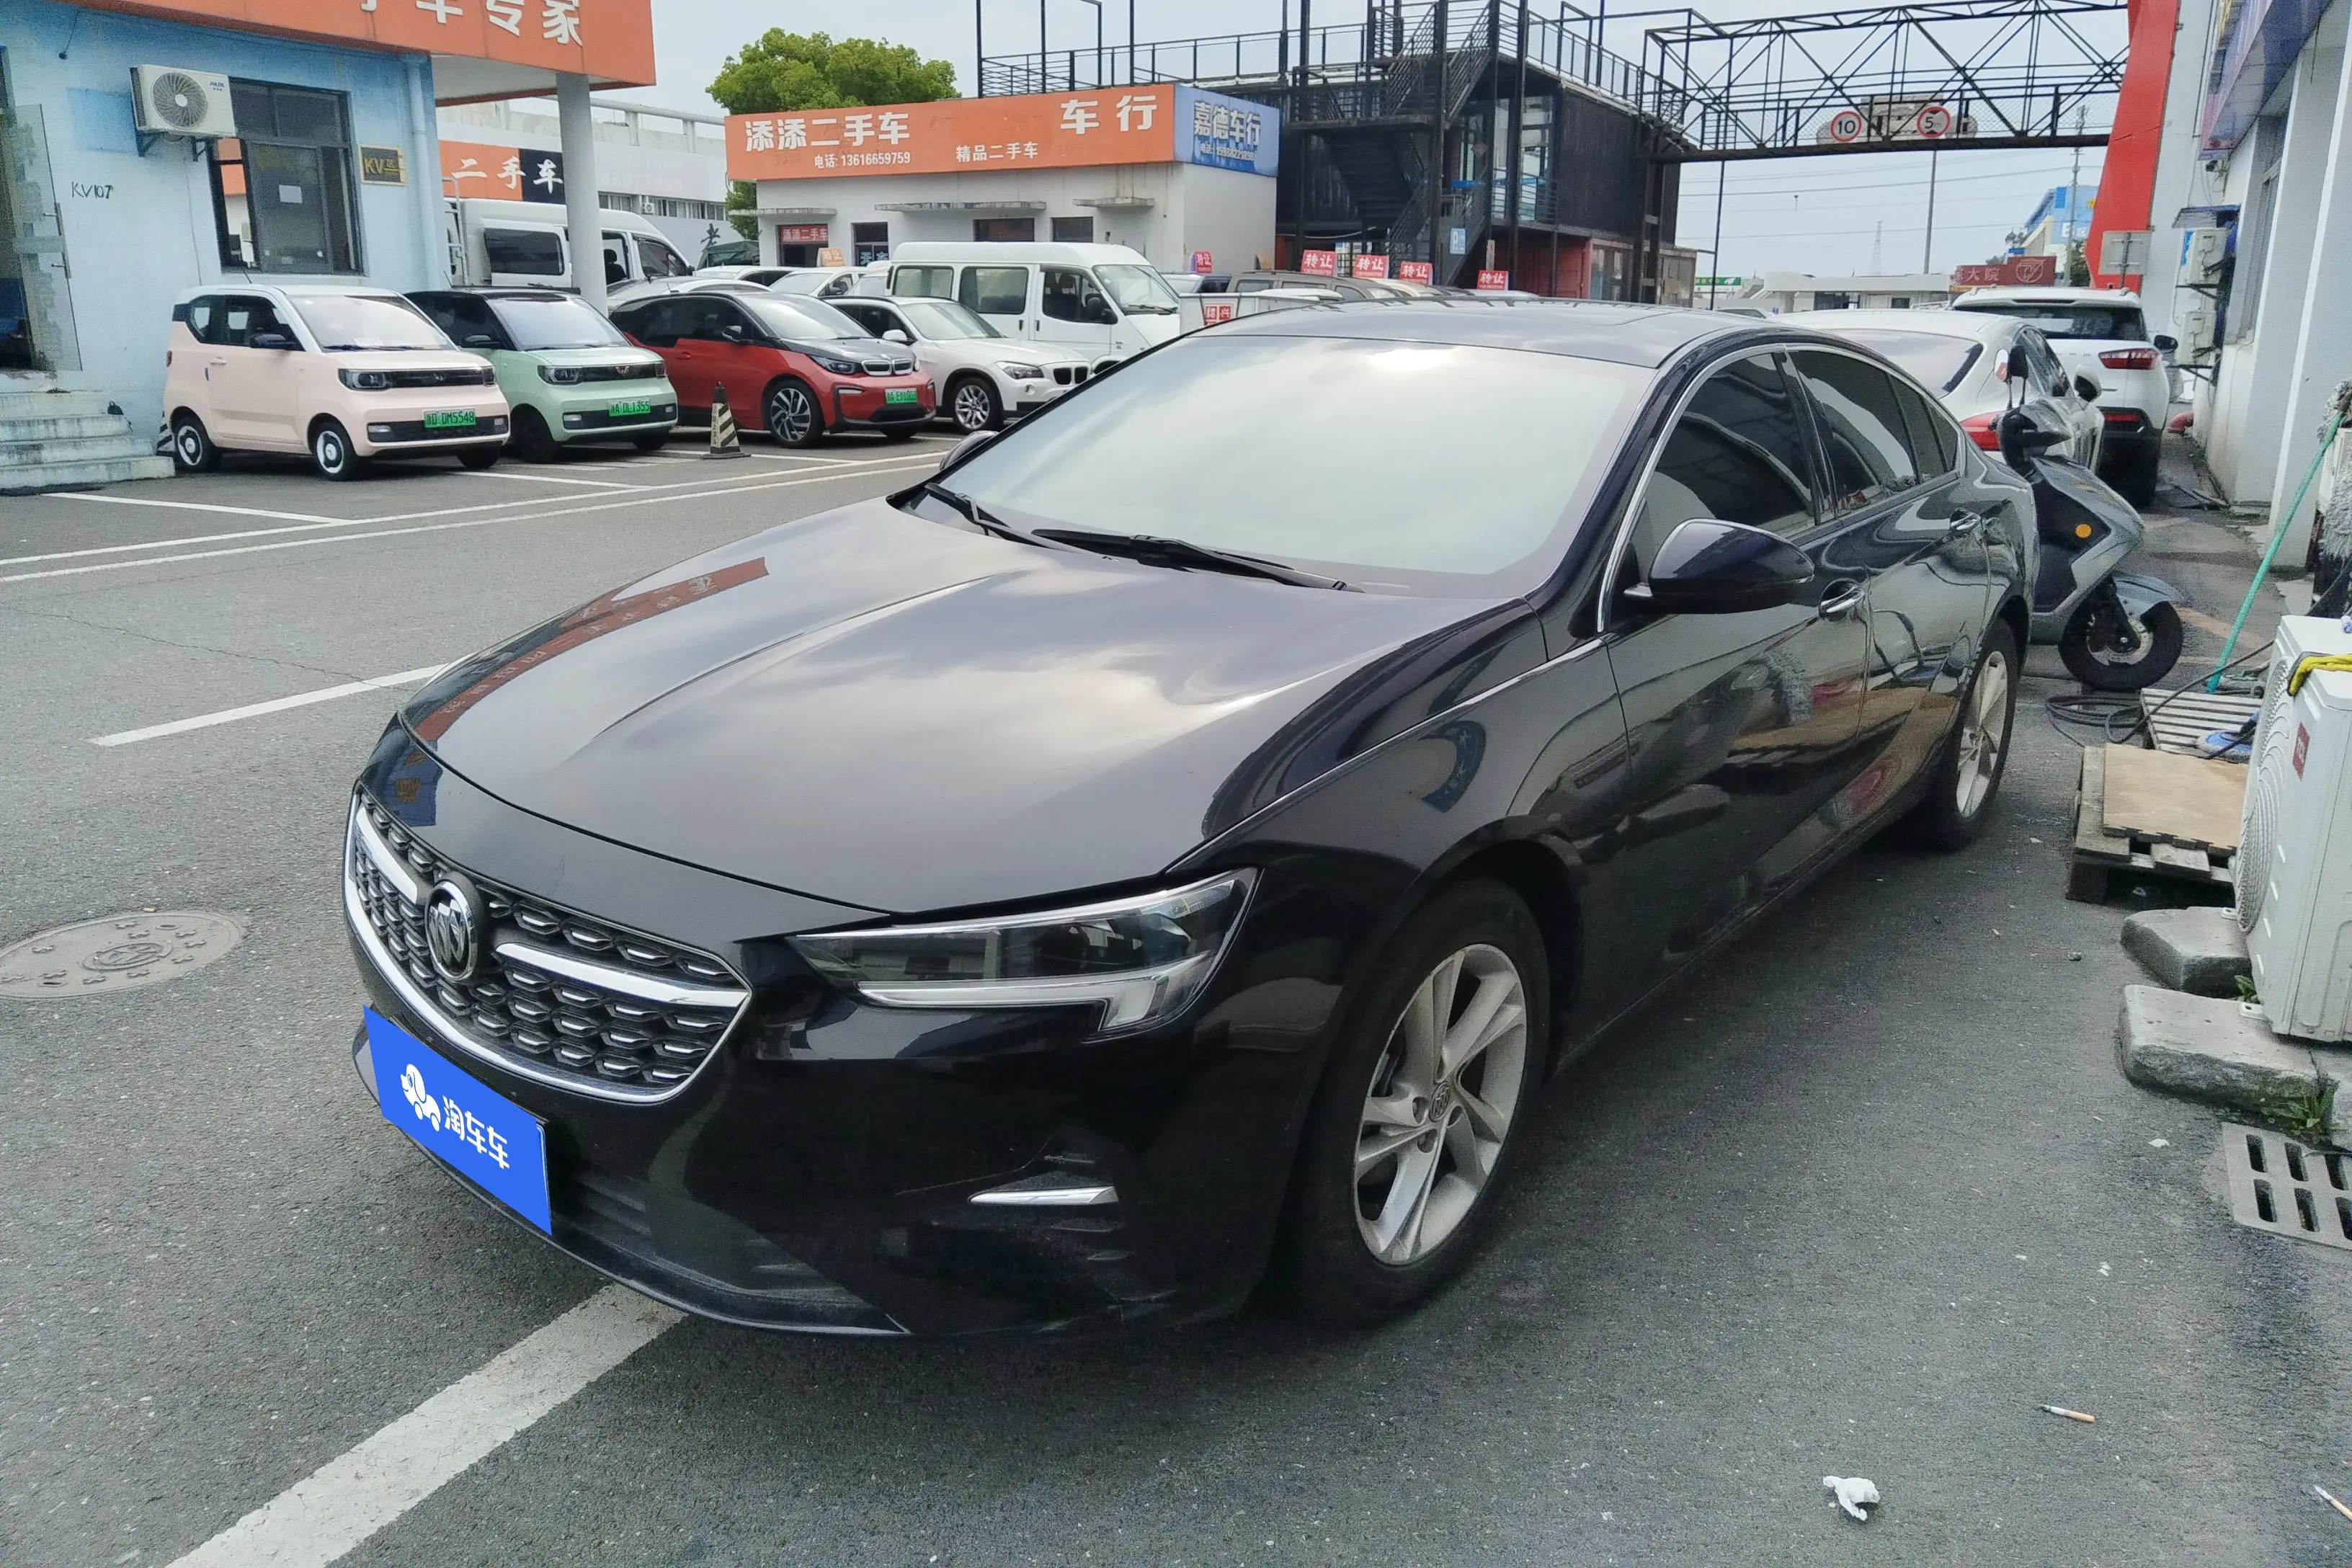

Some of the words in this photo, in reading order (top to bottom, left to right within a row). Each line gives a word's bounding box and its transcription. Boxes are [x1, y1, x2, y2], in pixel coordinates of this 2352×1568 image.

[1194, 102, 1261, 146] 嘉德车行
[1838, 120, 1856, 134] 10
[745, 112, 909, 152] 添添二手车
[956, 141, 1038, 162] 精品二手车
[452, 155, 564, 195] 二手车
[783, 228, 827, 242] 添添二手车
[1304, 254, 1332, 269] 转让
[1356, 258, 1384, 271] 转让
[1402, 264, 1427, 277] 转让
[1480, 273, 1505, 284] 转让
